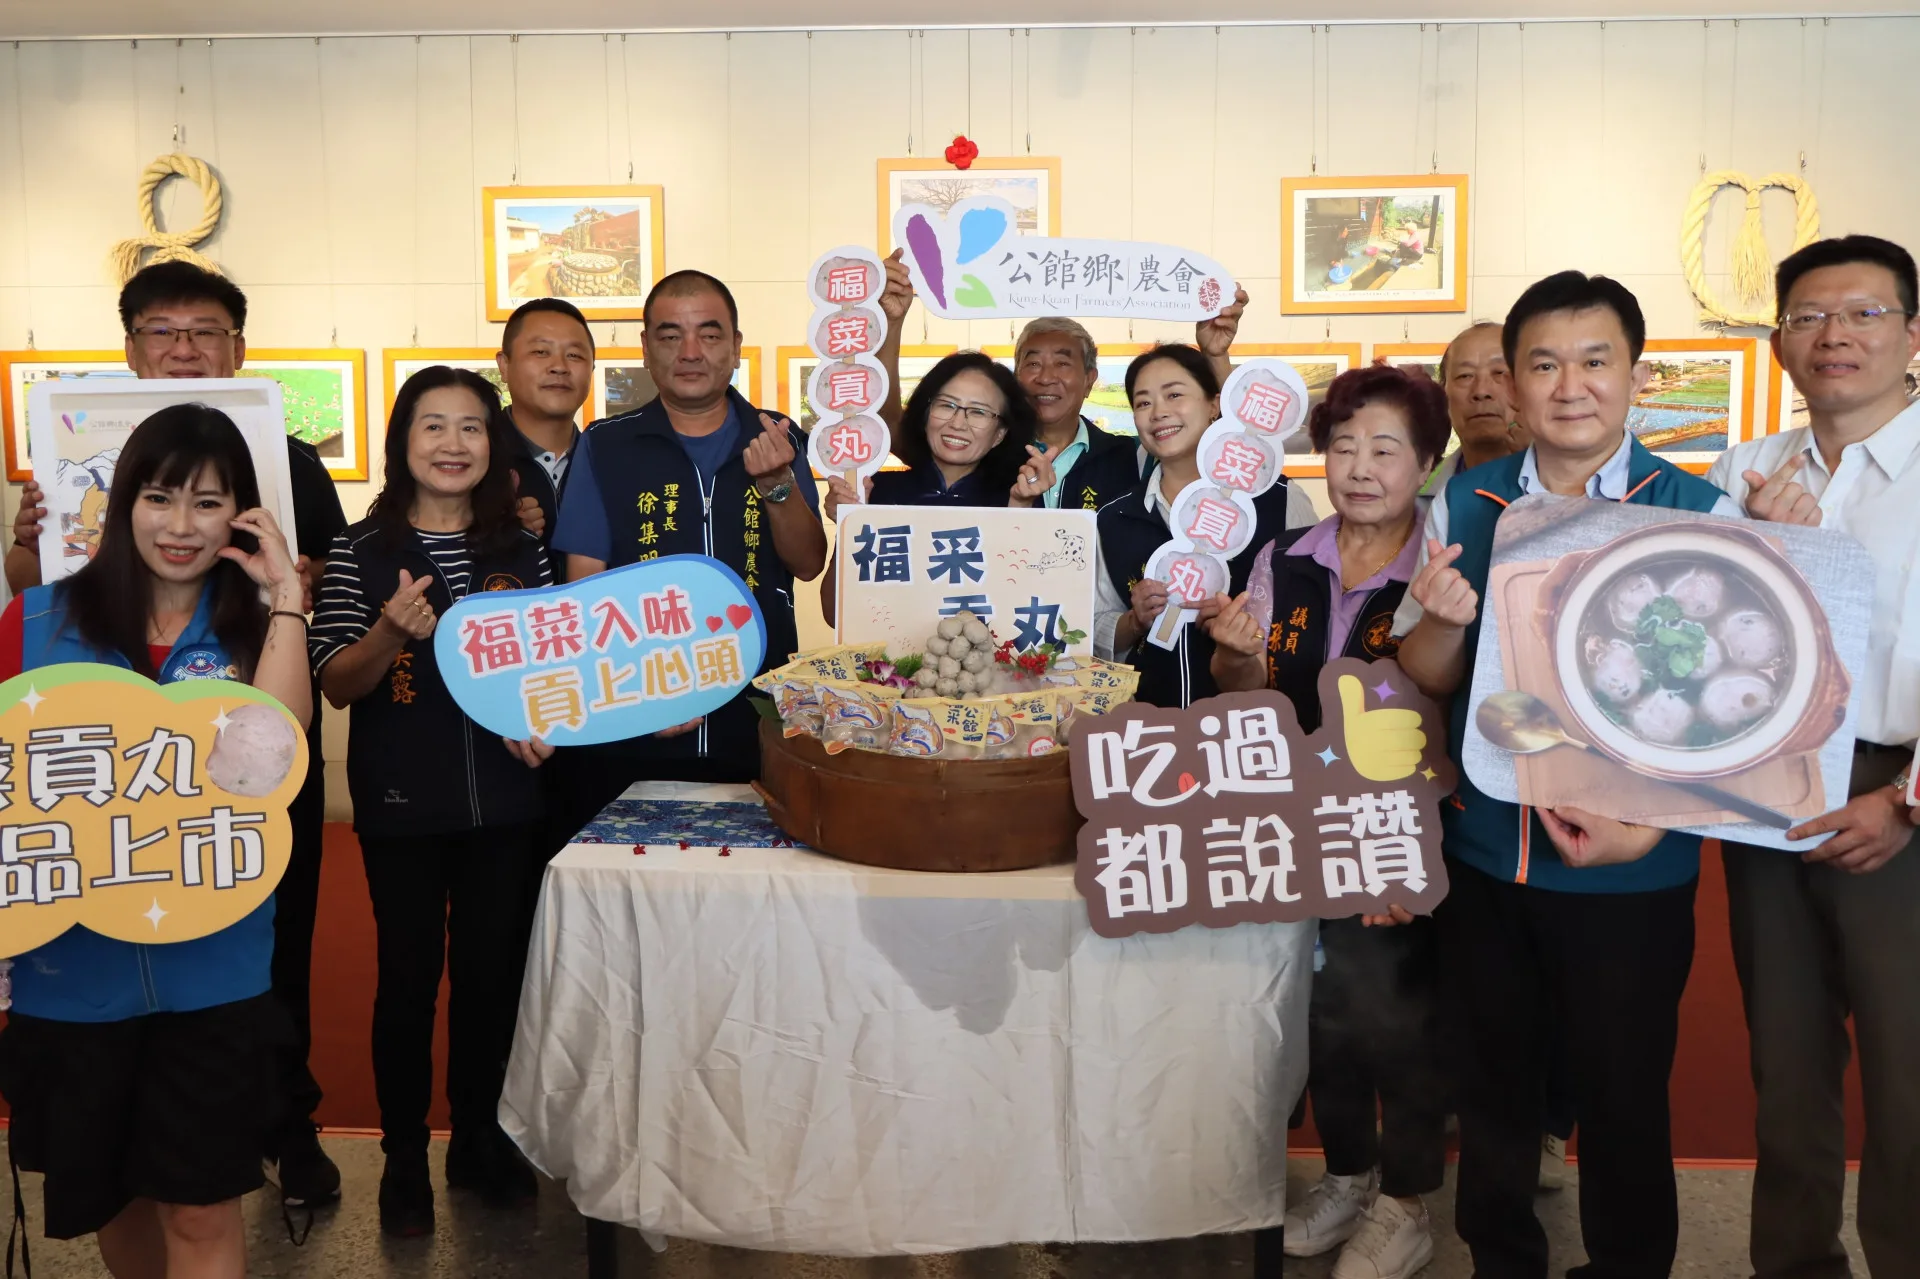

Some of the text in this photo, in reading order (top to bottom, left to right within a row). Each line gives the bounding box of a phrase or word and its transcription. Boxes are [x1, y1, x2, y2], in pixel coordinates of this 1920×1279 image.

[1008, 293, 1071, 309] Kung-Kuan
[1122, 296, 1191, 310] Association
[828, 265, 871, 465] 福菜貢丸
[662, 483, 680, 531] 理事長
[1165, 382, 1292, 604] 福菜貢丸
[852, 524, 985, 585] 福采
[462, 588, 692, 674] 福菜入味
[1284, 606, 1308, 655] 議員
[524, 638, 743, 734] 貢上心頭
[1088, 706, 1293, 807] 吃過
[0, 805, 267, 908] 品上市
[1094, 790, 1428, 918] 都說讚
